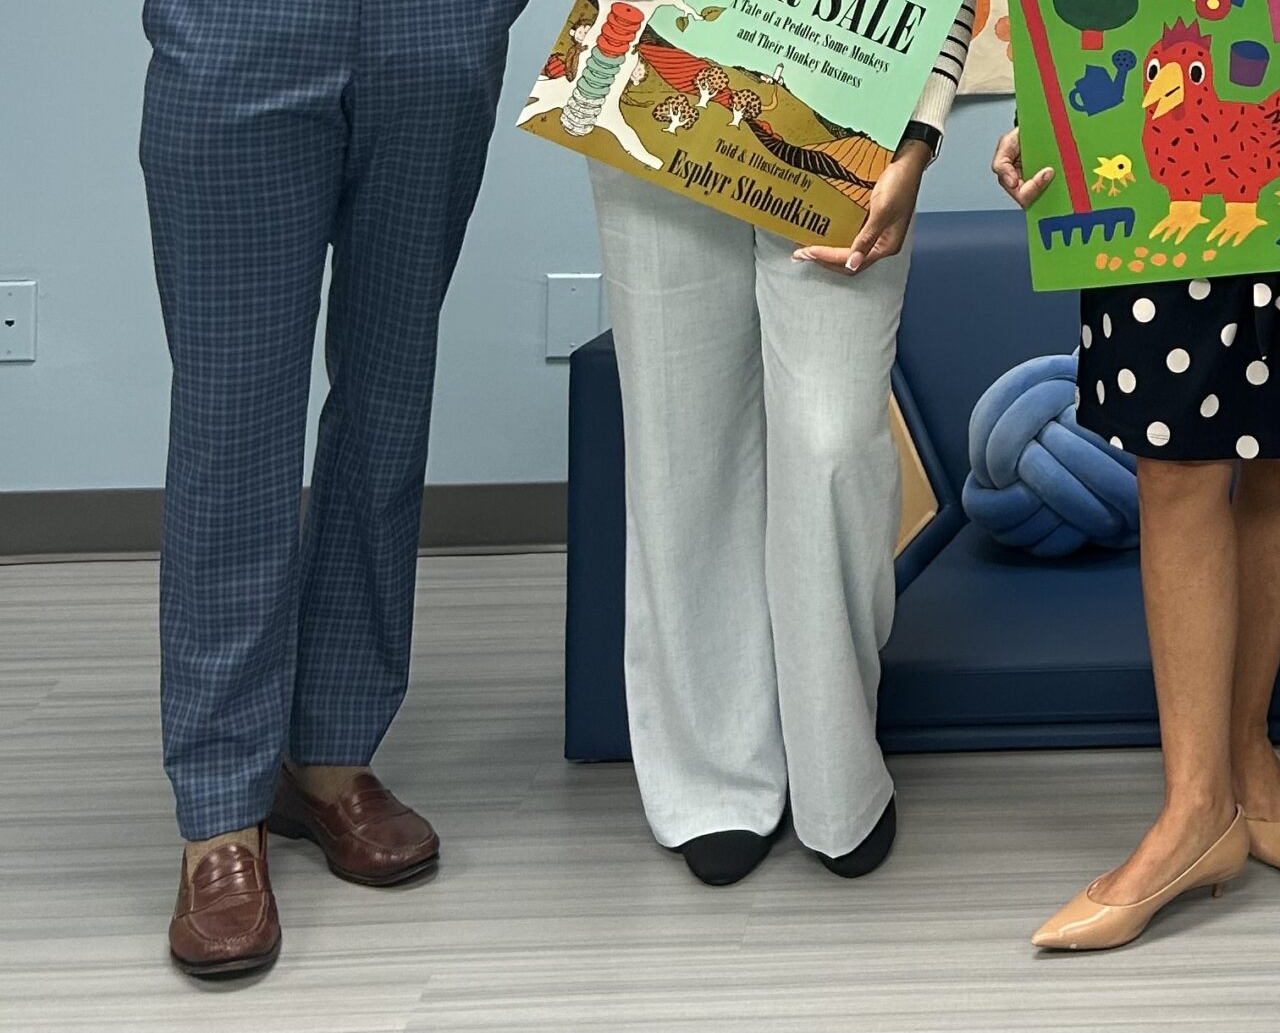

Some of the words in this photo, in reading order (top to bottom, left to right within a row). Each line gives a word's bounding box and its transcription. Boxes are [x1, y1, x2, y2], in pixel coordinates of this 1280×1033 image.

[737, 27, 756, 44] and
[756, 32, 784, 54] Their
[785, 46, 821, 74] Monkey
[821, 62, 863, 88] Business
[763, 11, 775, 27] of
[774, 17, 781, 27] a
[784, 17, 821, 46] Peddler,
[822, 34, 850, 56] Some
[850, 47, 890, 74] Monkeys
[666, 148, 732, 195] Esphyr
[731, 175, 832, 237] Slobodkina
[715, 138, 739, 159] Told
[738, 150, 746, 163] &
[748, 152, 801, 185] Illustrated
[800, 174, 814, 192] by
